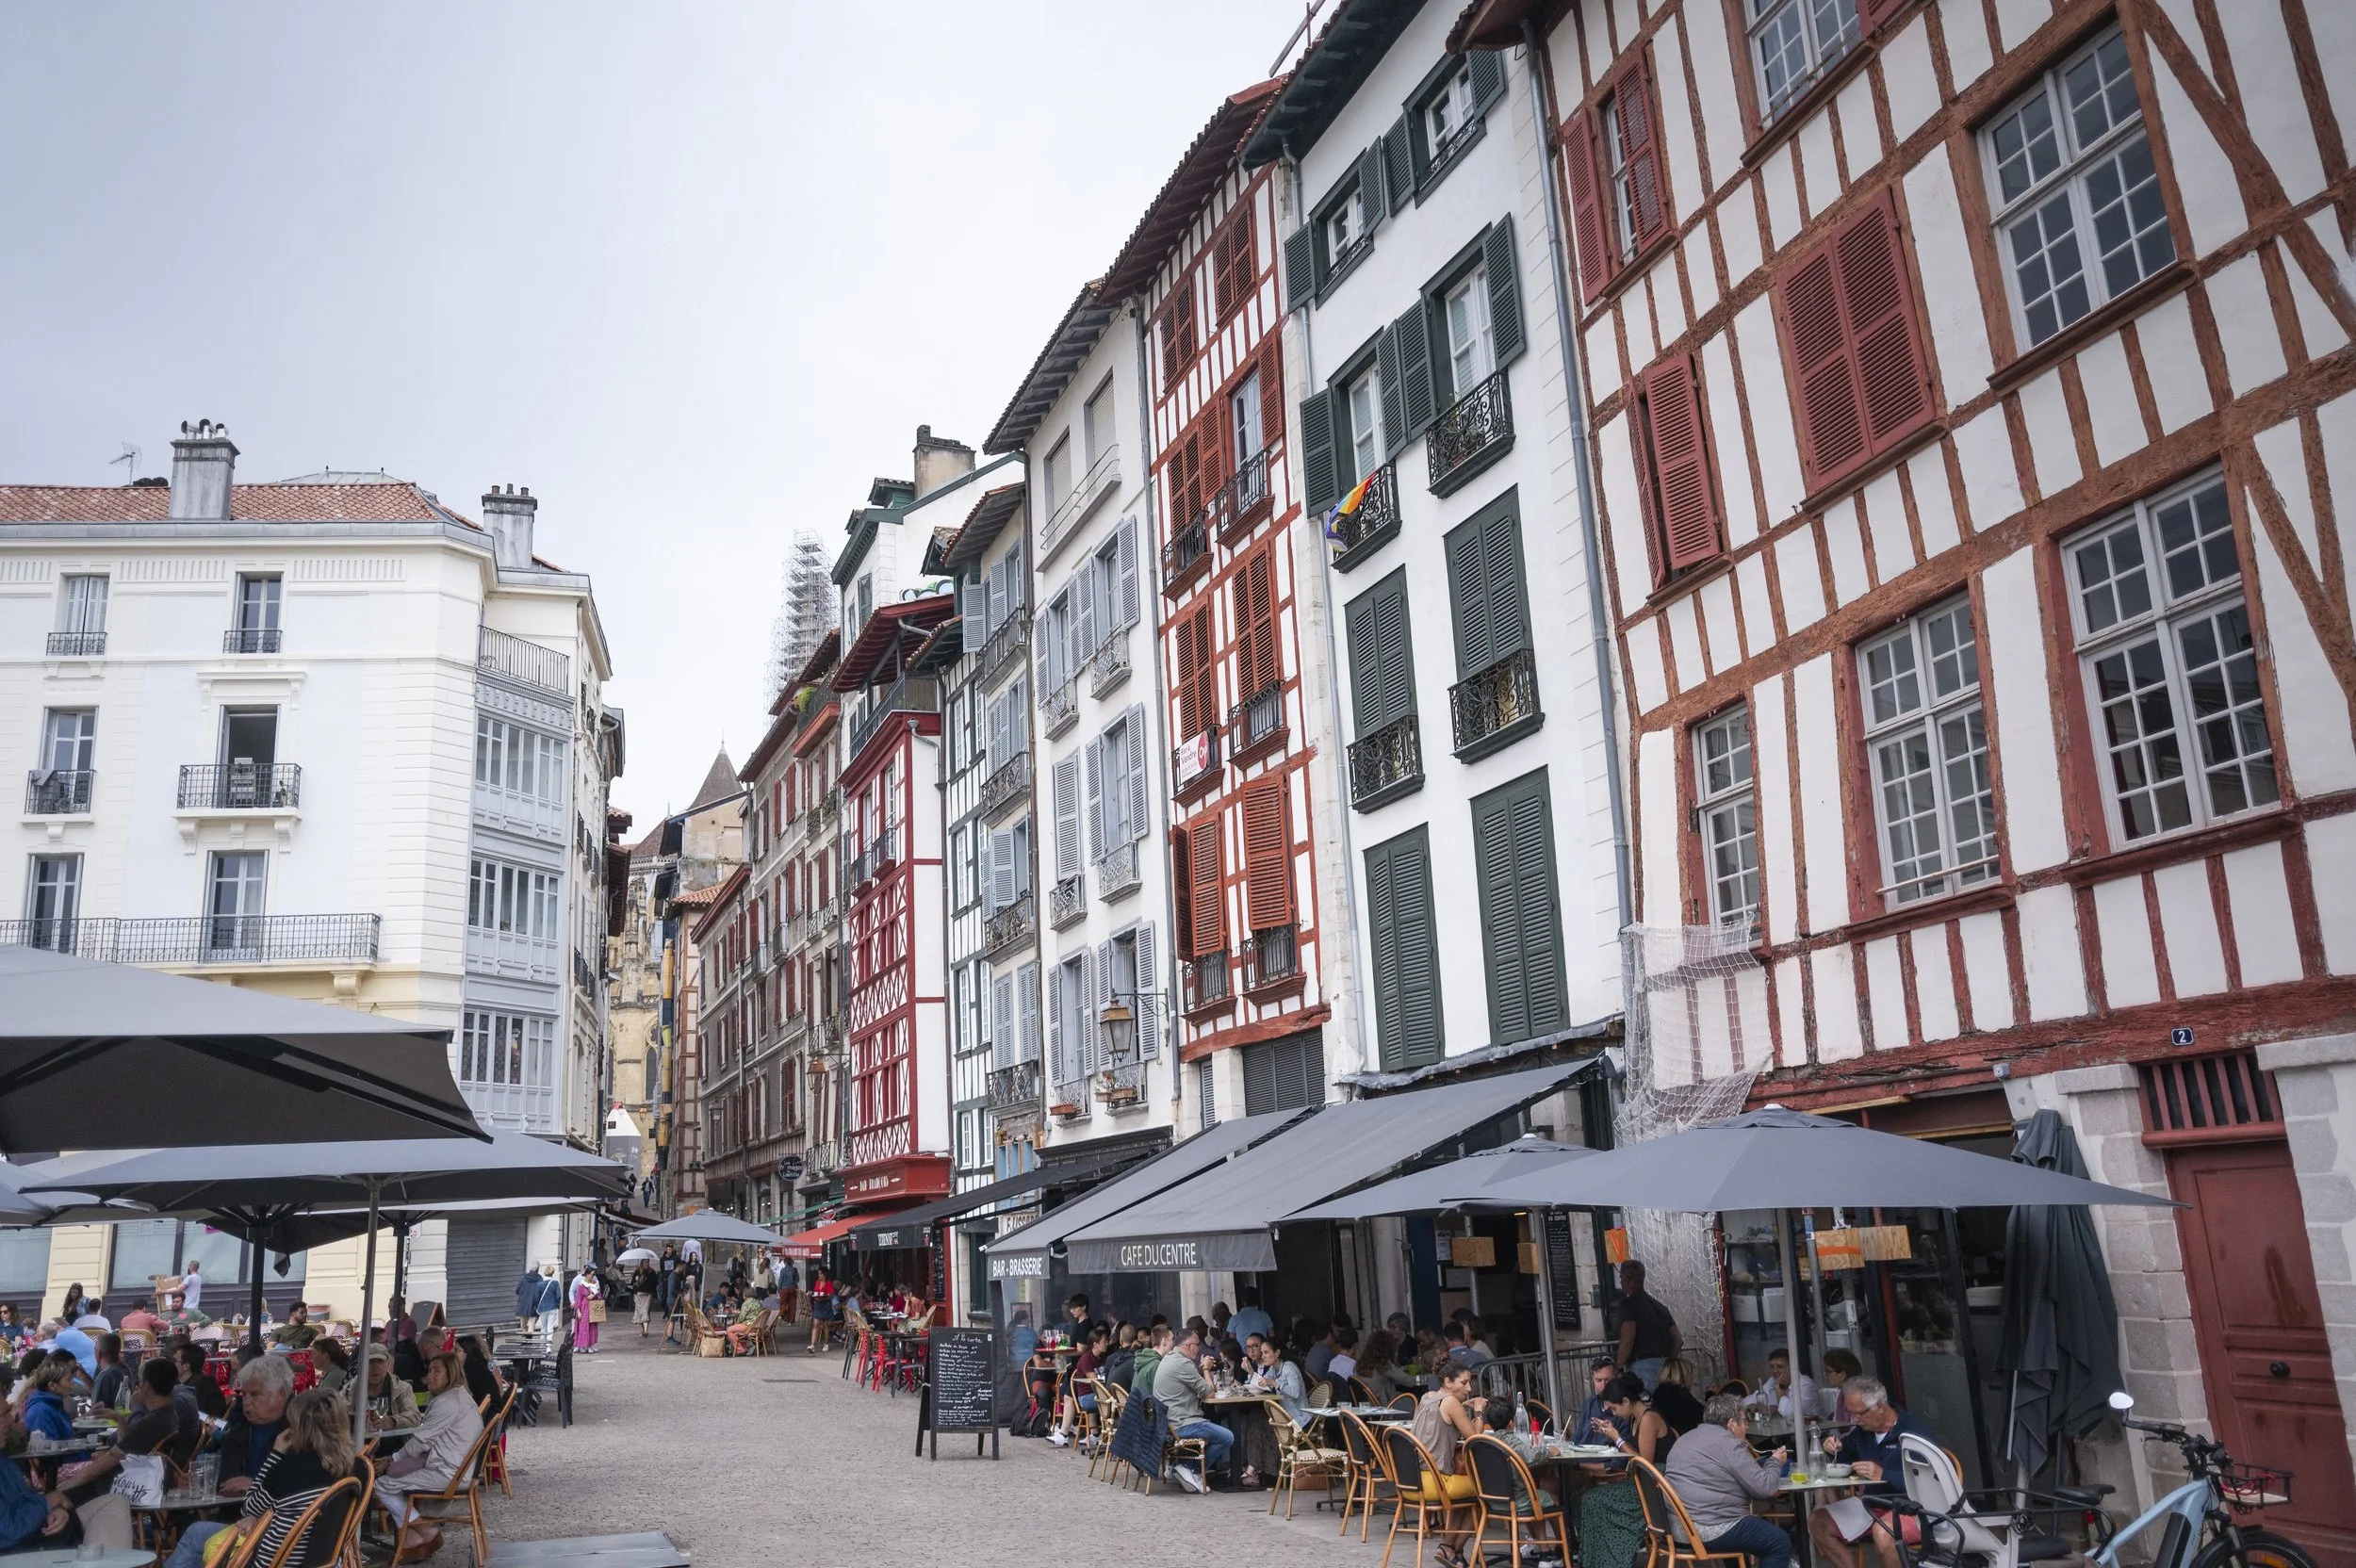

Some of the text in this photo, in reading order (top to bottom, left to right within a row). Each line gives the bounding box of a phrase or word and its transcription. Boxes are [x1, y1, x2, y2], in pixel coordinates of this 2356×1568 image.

[2178, 1030, 2187, 1043] 2
[1121, 1245, 1143, 1266] CAFE
[1159, 1242, 1197, 1266] CENTRE
[992, 1260, 1006, 1277] BAR
[1009, 1257, 1043, 1276] BRASSERIE
